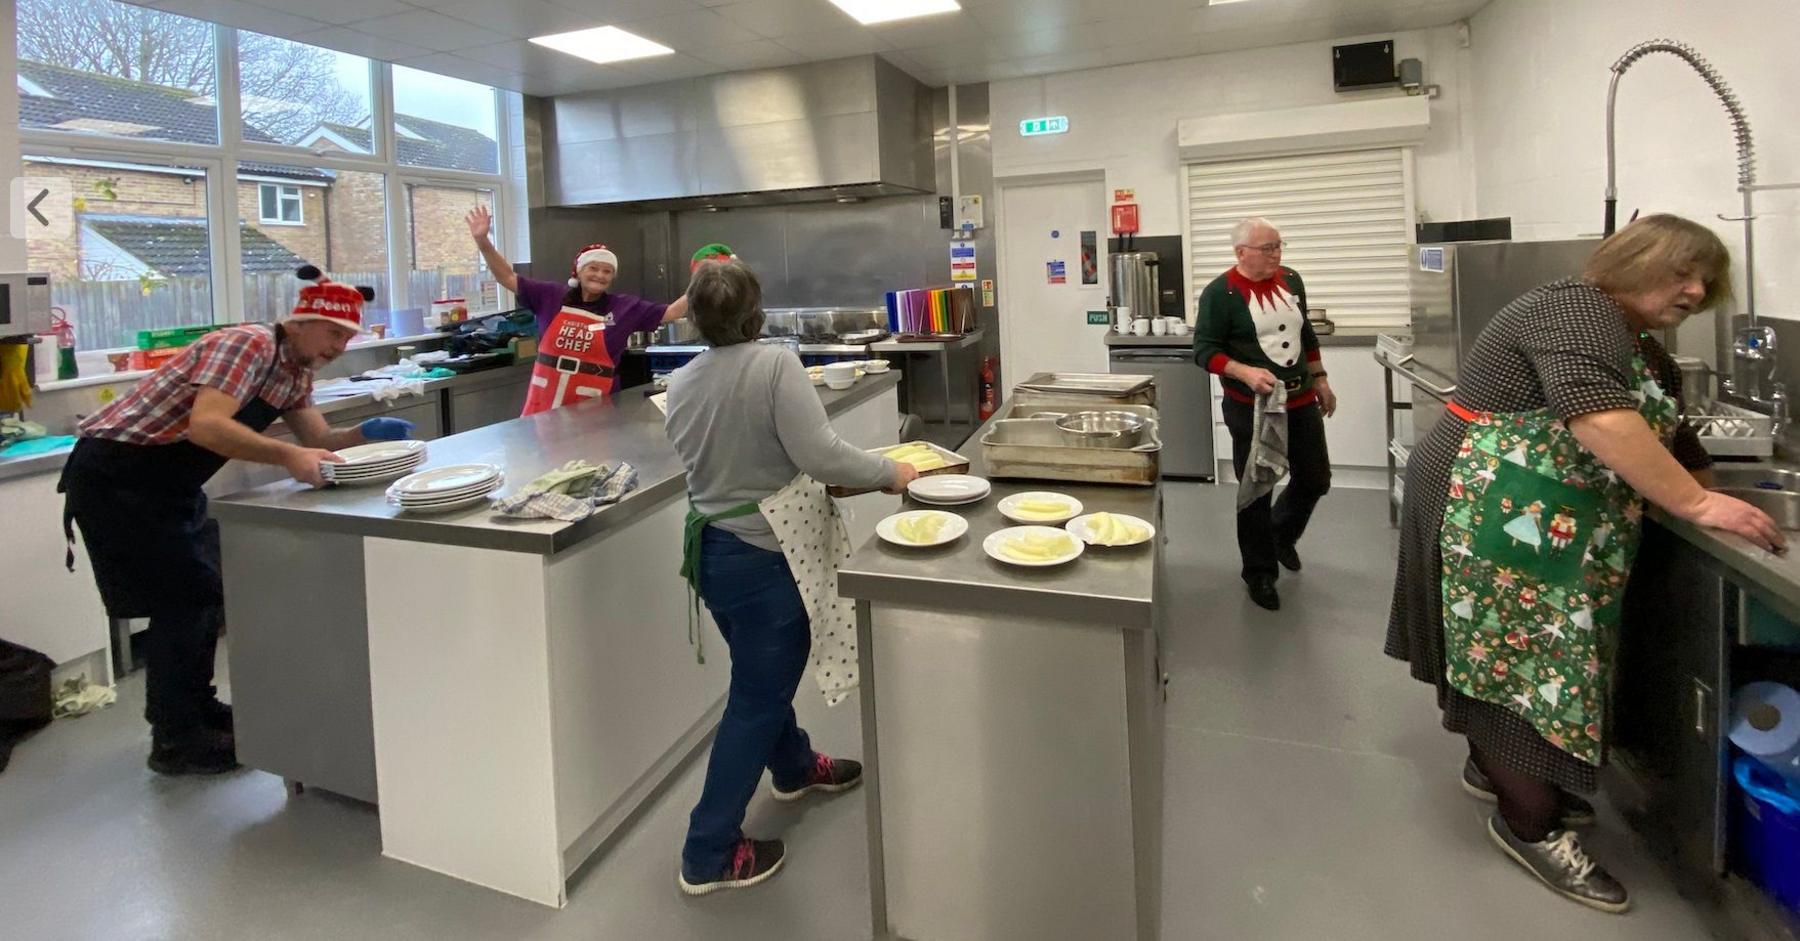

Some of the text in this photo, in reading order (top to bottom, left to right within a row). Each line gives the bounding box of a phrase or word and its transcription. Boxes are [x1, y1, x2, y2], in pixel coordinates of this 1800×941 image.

[1088, 313, 1108, 323] PUSH
[559, 325, 594, 340] HEAD
[555, 336, 591, 352] CHEF
